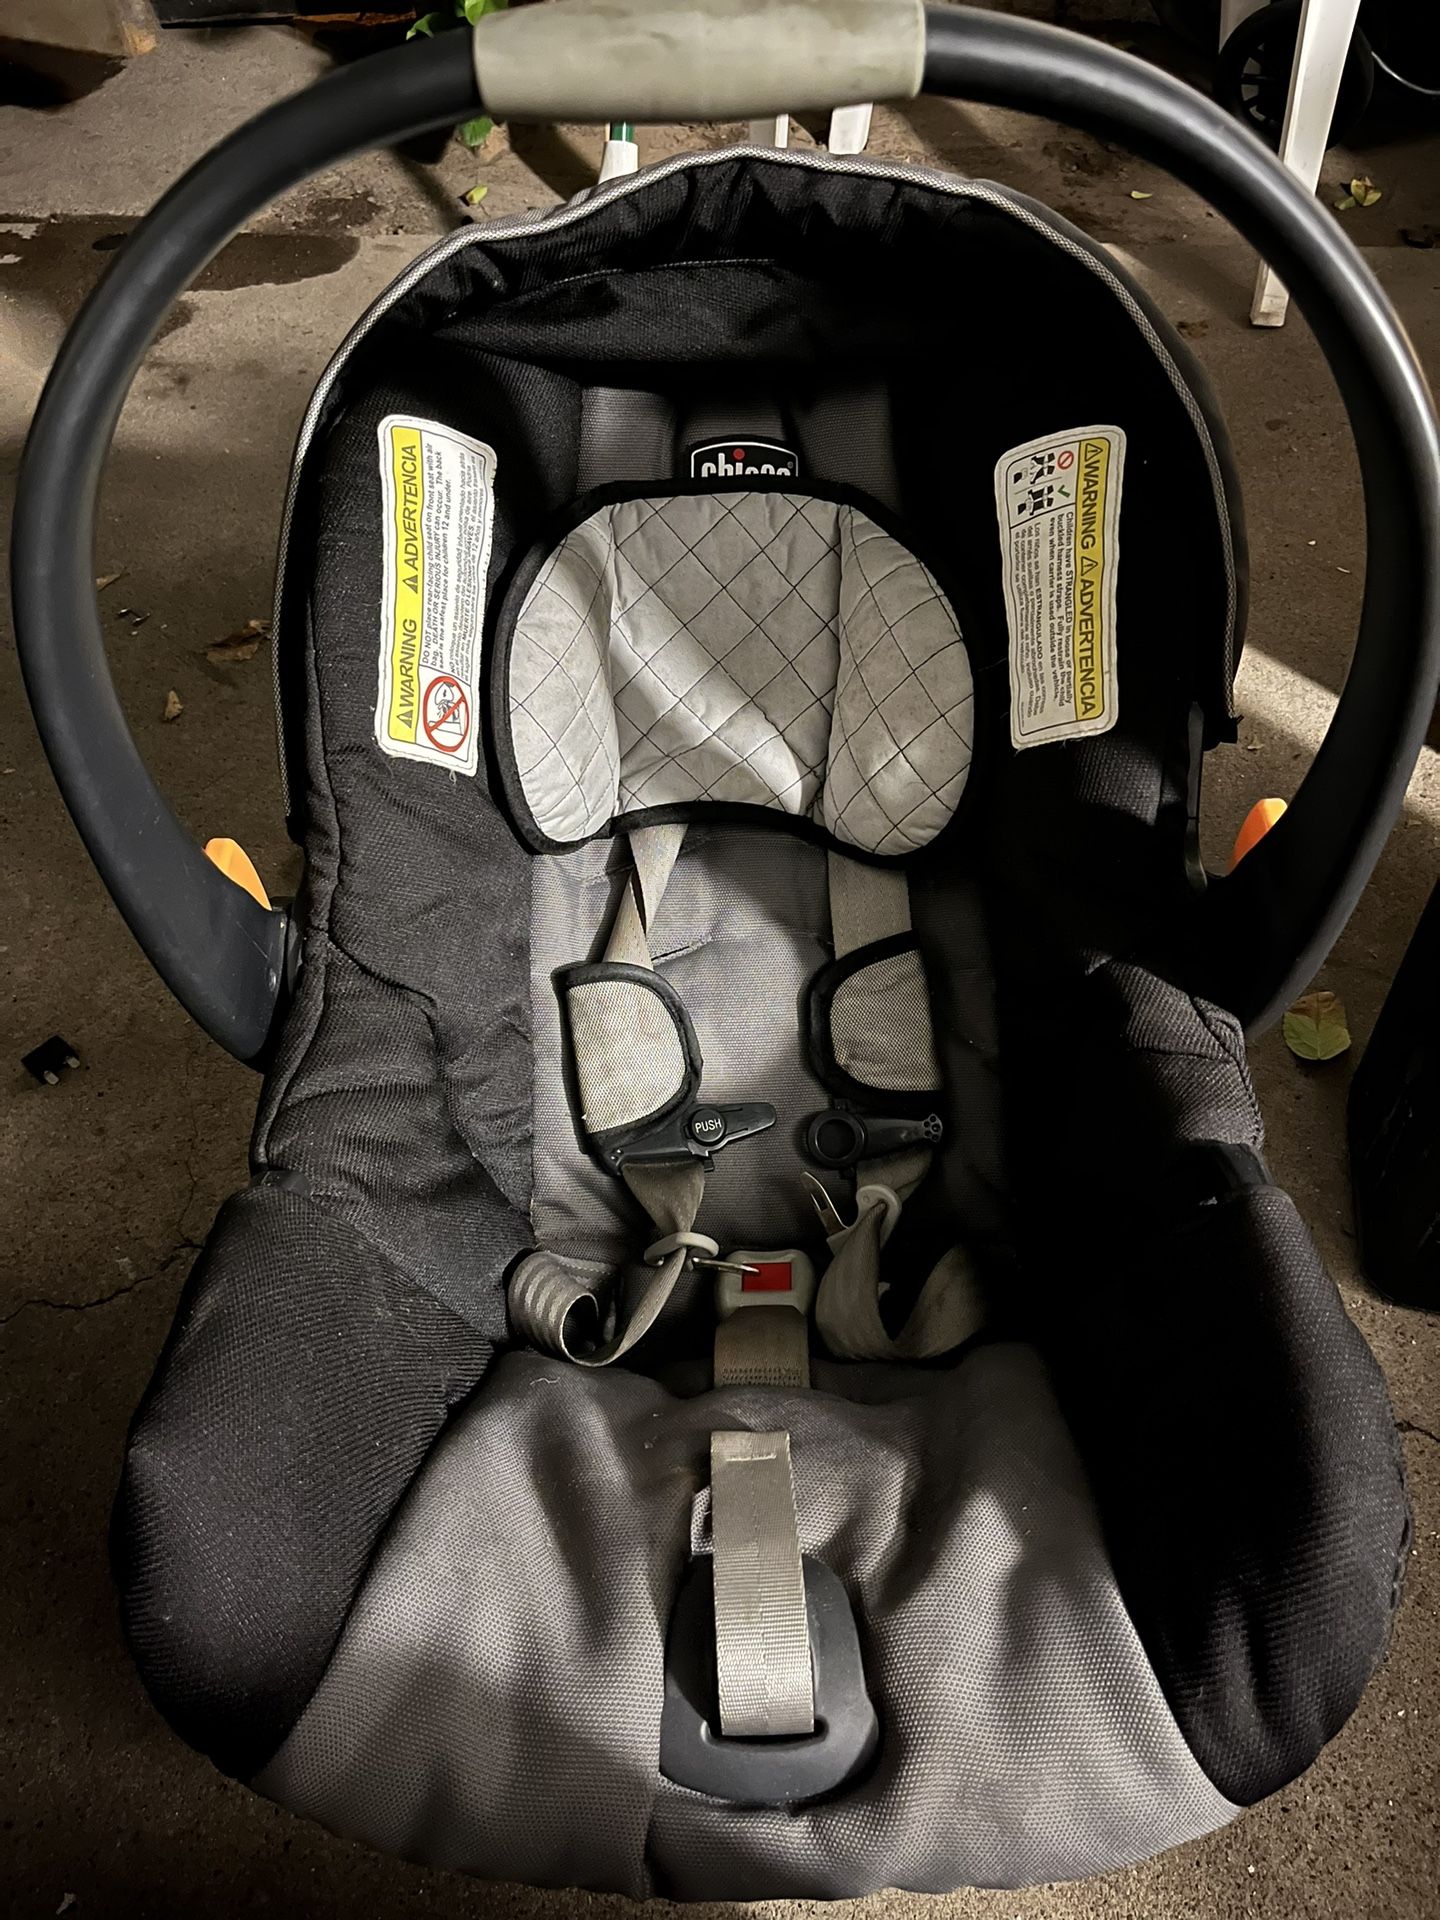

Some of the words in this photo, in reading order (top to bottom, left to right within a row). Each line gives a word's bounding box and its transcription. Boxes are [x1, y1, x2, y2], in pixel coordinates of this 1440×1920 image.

[402, 444, 418, 571] ADVERTENCIA
[426, 491, 434, 510] front
[1081, 460, 1100, 550] WARNING
[426, 512, 432, 522] on
[442, 521, 449, 530] 12
[1055, 583, 1063, 612] straps.
[1065, 570, 1073, 623] STRANGLED
[433, 602, 438, 614] OR
[1066, 625, 1072, 633] in
[1079, 578, 1095, 716] ADVERTENCIA
[399, 618, 417, 708] WARNING
[422, 651, 429, 663] DO
[1066, 660, 1072, 668] or
[694, 1118, 722, 1133] PUSH
